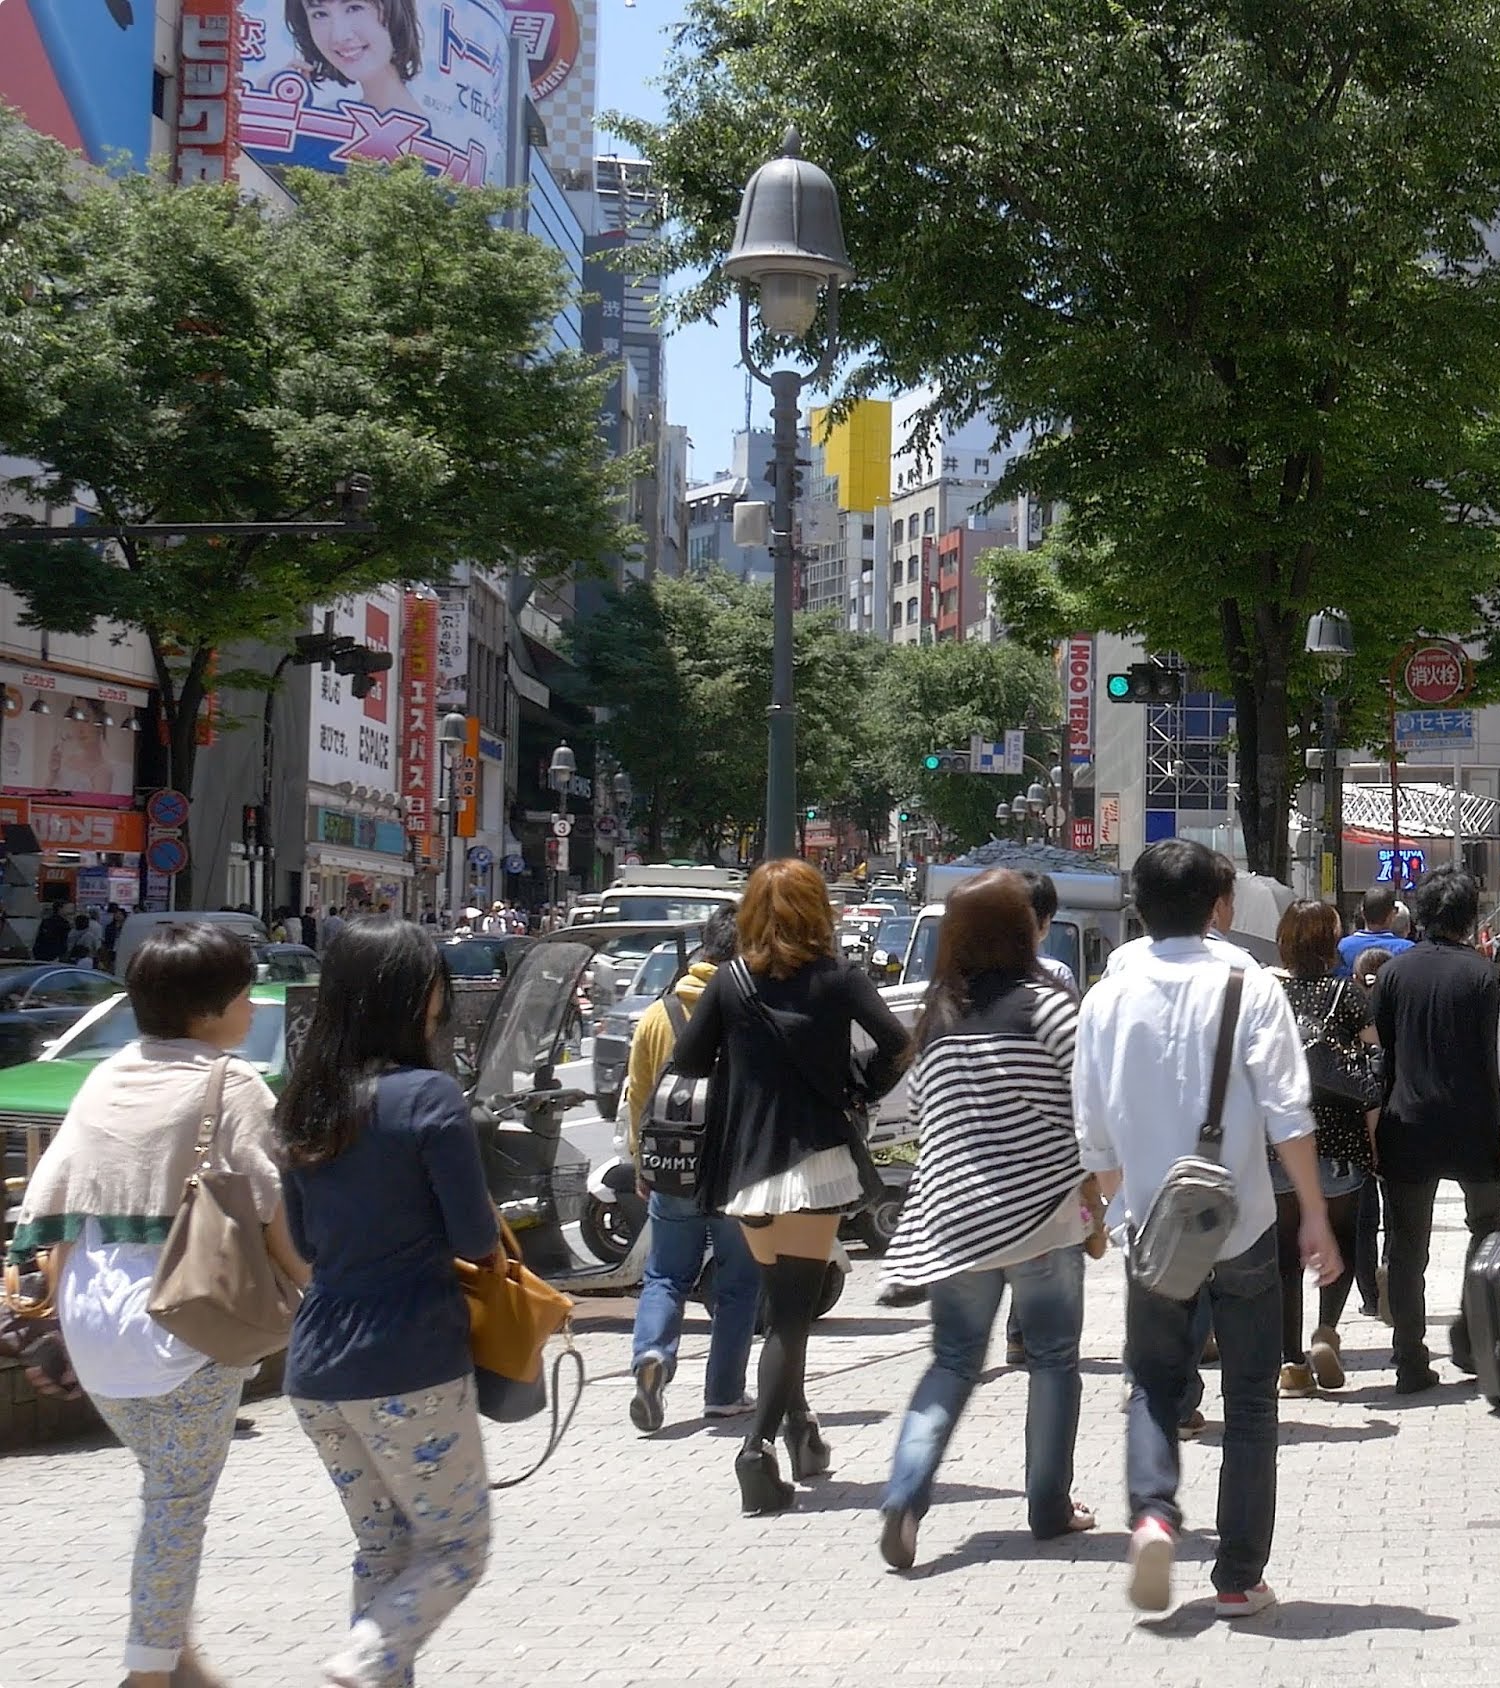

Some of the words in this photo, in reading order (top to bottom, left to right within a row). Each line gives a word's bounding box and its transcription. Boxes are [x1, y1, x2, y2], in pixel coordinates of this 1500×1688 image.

[1411, 664, 1458, 687] 消火栓
[1069, 645, 1091, 746] HOOTERS
[1416, 712, 1472, 731] セキネ
[359, 724, 390, 770] ESPACE
[559, 823, 567, 834] 3
[1074, 823, 1093, 834] UNI
[1074, 835, 1093, 847] QLO
[1379, 850, 1424, 861] SHUYA
[641, 1153, 698, 1170] TOMMY
